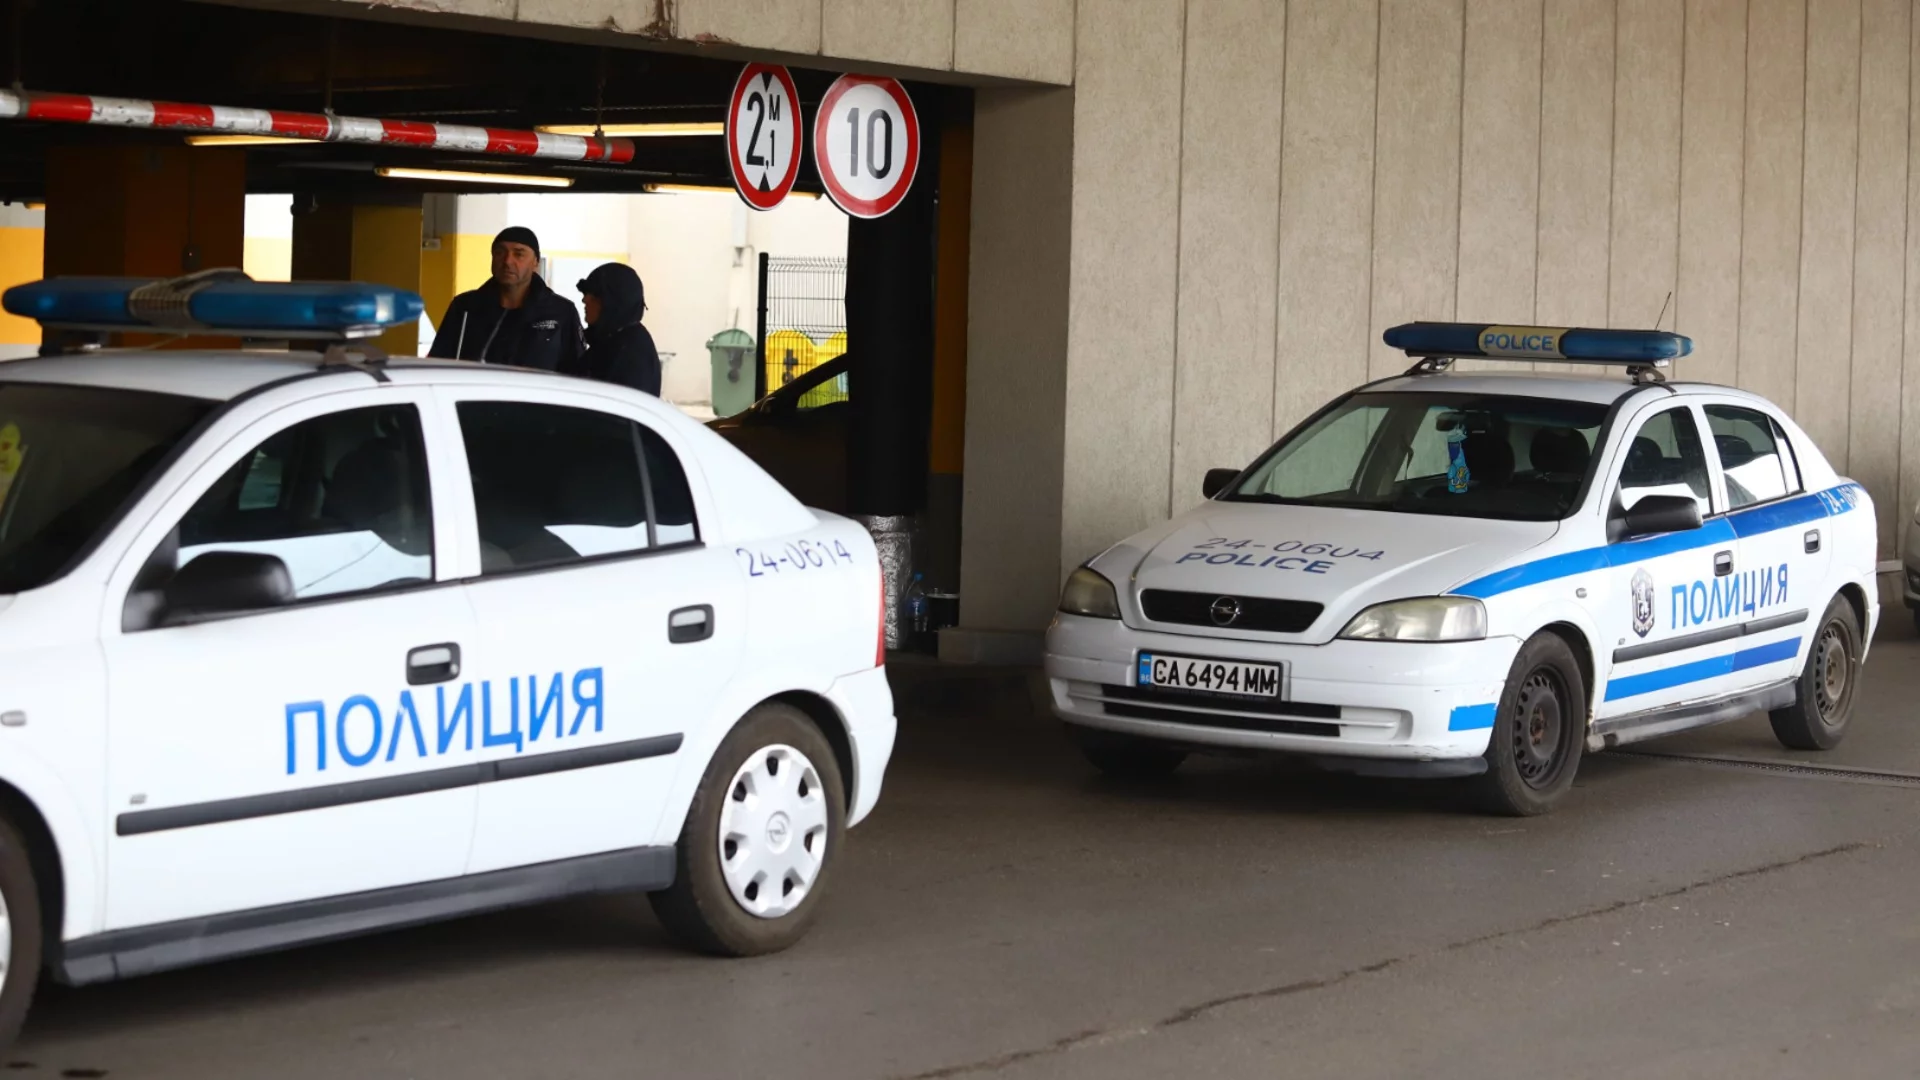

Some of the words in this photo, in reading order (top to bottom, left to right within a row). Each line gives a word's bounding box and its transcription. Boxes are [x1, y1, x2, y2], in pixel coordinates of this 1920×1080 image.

[846, 107, 893, 180] 10
[1483, 333, 1554, 351] POLICE
[735, 539, 853, 577] 24-0614
[1175, 552, 1336, 574] POLICE
[1671, 563, 1788, 629] ПОЛИЦИЯ
[1185, 662, 1239, 691] 6494
[1244, 667, 1277, 694] MM
[285, 666, 604, 775] ПОЛИЦИЯ
